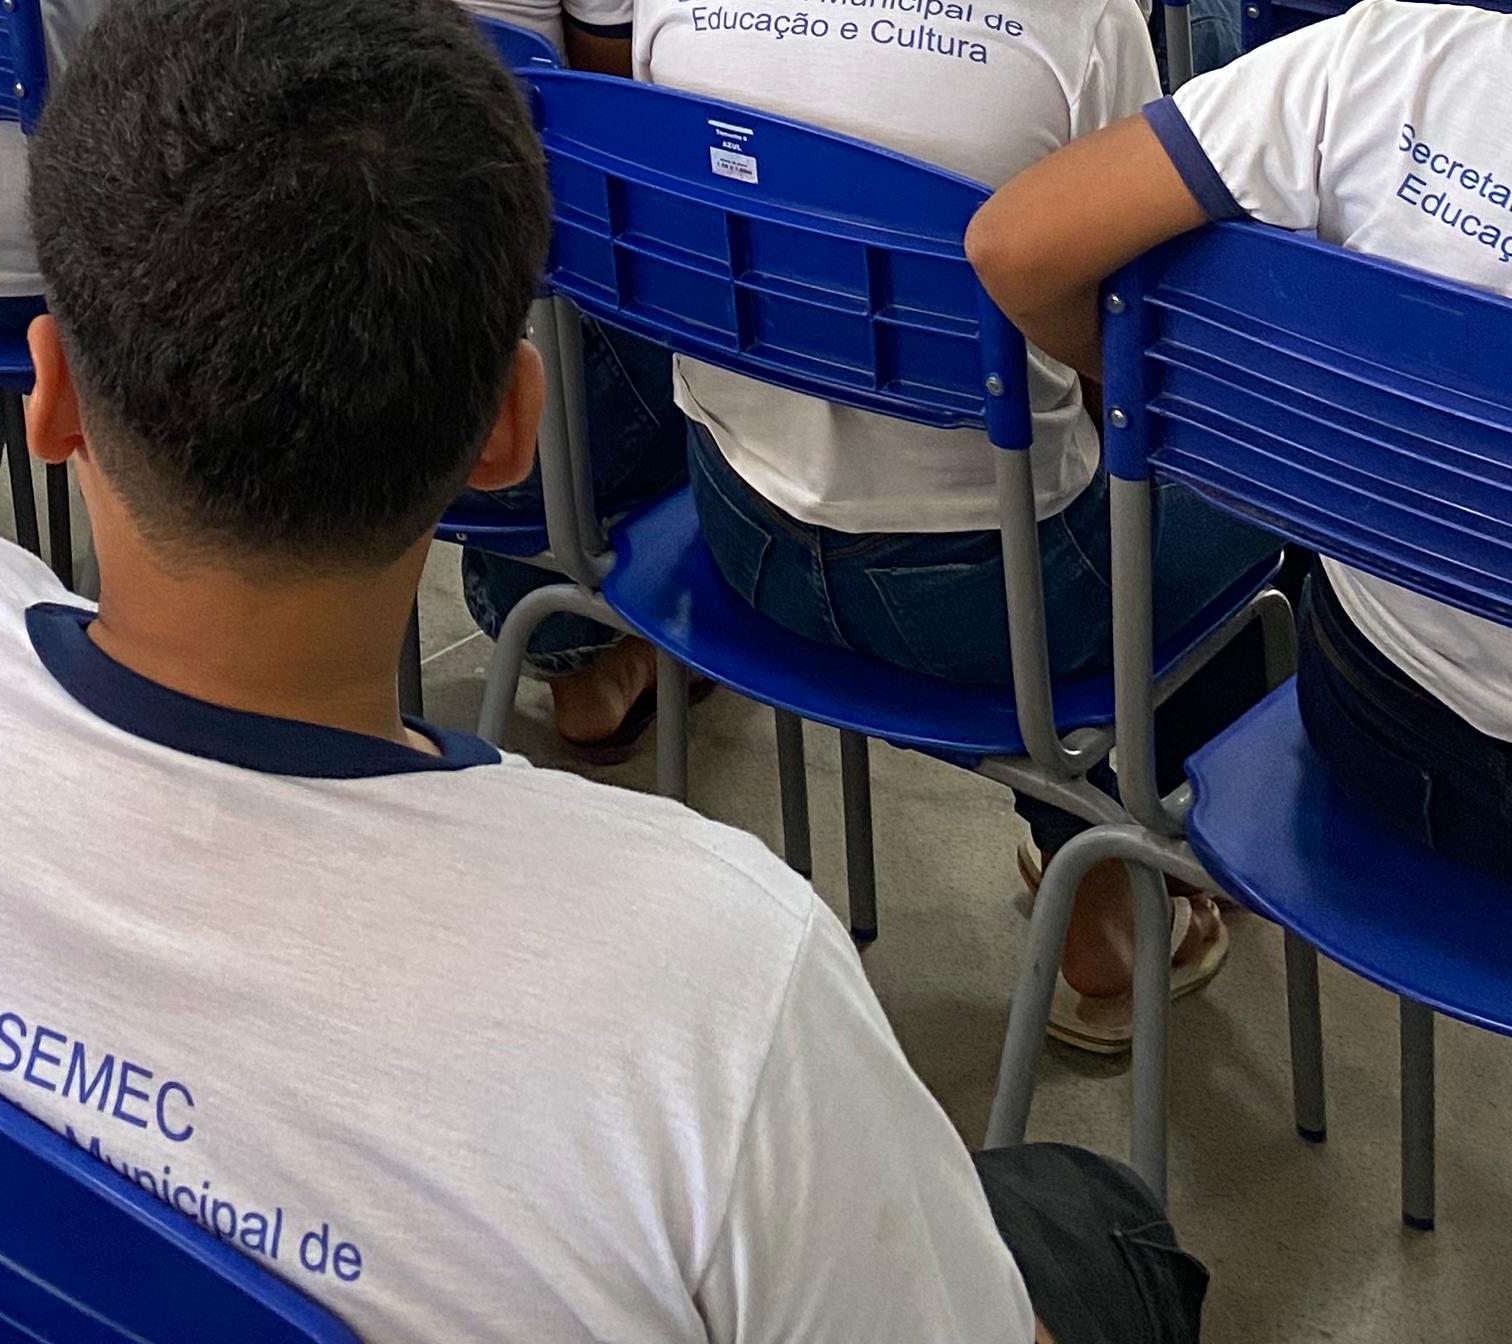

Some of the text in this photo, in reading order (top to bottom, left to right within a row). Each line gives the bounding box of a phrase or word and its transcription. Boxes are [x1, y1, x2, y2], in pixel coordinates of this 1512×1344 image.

[692, 6, 988, 64] Educação e Cultura
[984, 13, 1024, 37] de
[1399, 123, 1512, 212] Secreta
[299, 1223, 363, 1283] de
